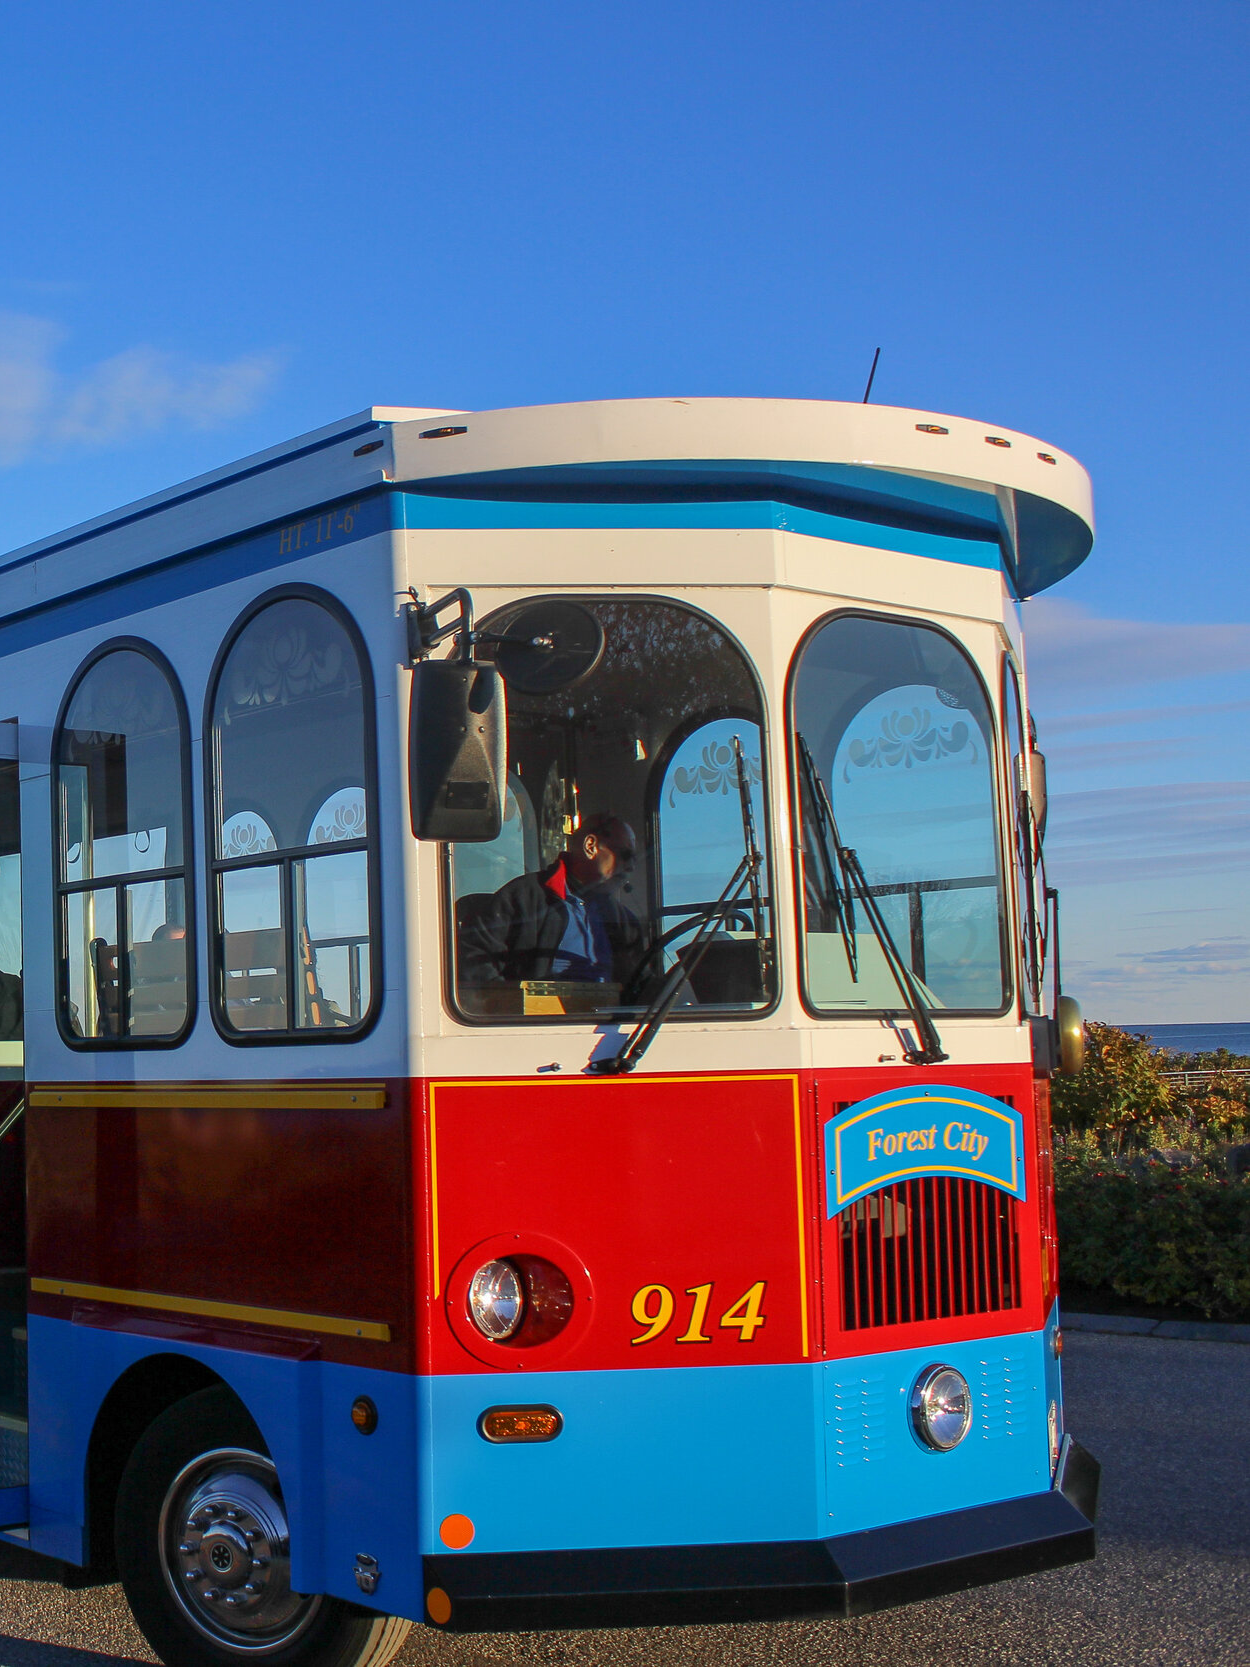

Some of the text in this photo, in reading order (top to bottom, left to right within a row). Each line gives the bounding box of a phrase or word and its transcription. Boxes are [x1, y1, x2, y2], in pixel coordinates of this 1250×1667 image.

[279, 522, 309, 555] HT.
[865, 1120, 989, 1163] Forest City
[629, 1279, 767, 1348] 914
